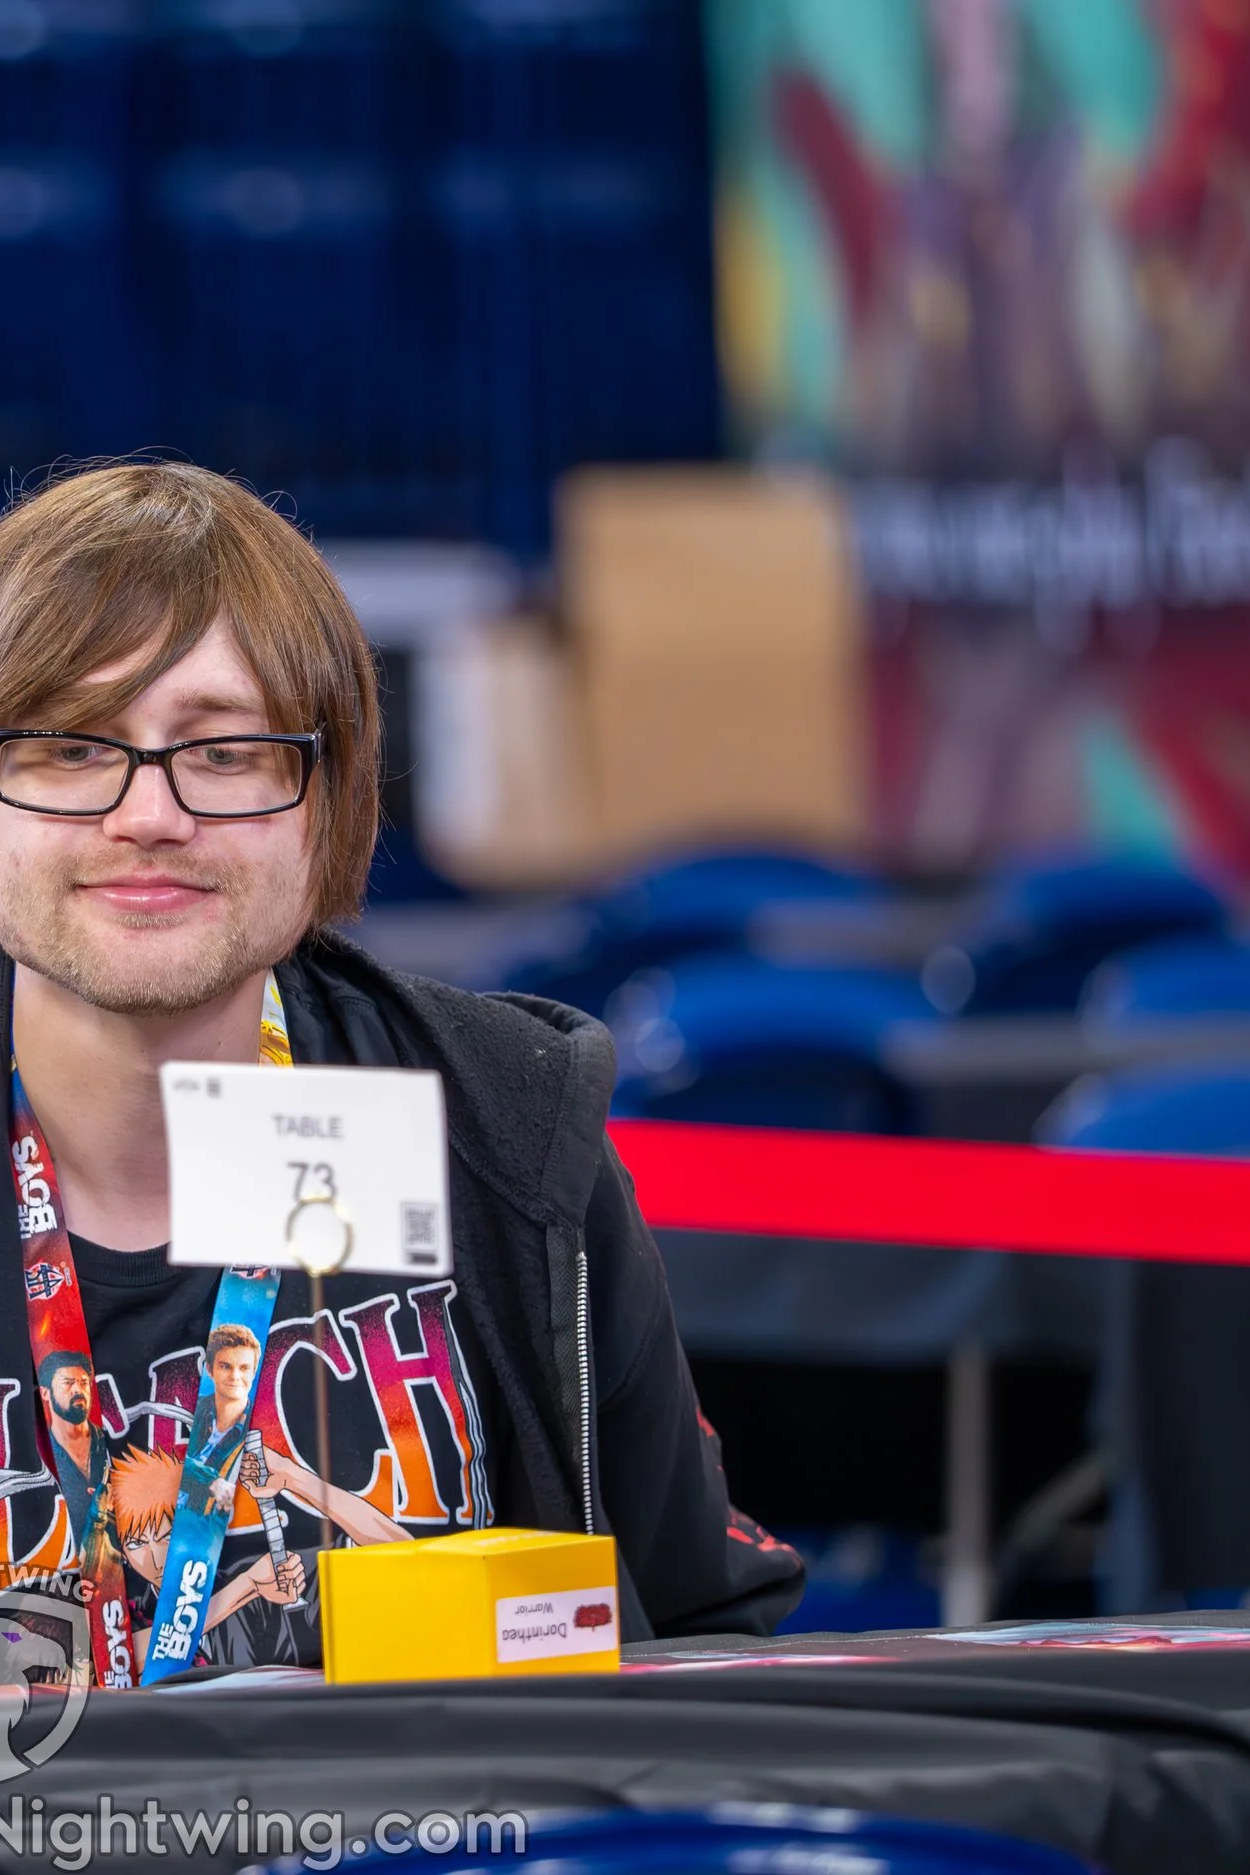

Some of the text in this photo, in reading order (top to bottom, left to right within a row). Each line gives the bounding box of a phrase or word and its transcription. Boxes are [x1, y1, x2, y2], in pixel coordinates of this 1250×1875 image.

[271, 1114, 344, 1140] TABLE
[12, 1135, 58, 1234] BOYS
[286, 1161, 338, 1202] 73
[167, 1559, 208, 1661] BOYS
[514, 1602, 554, 1616] Warrior
[152, 1622, 174, 1661] THE
[502, 1621, 567, 1643] Dorinthea
